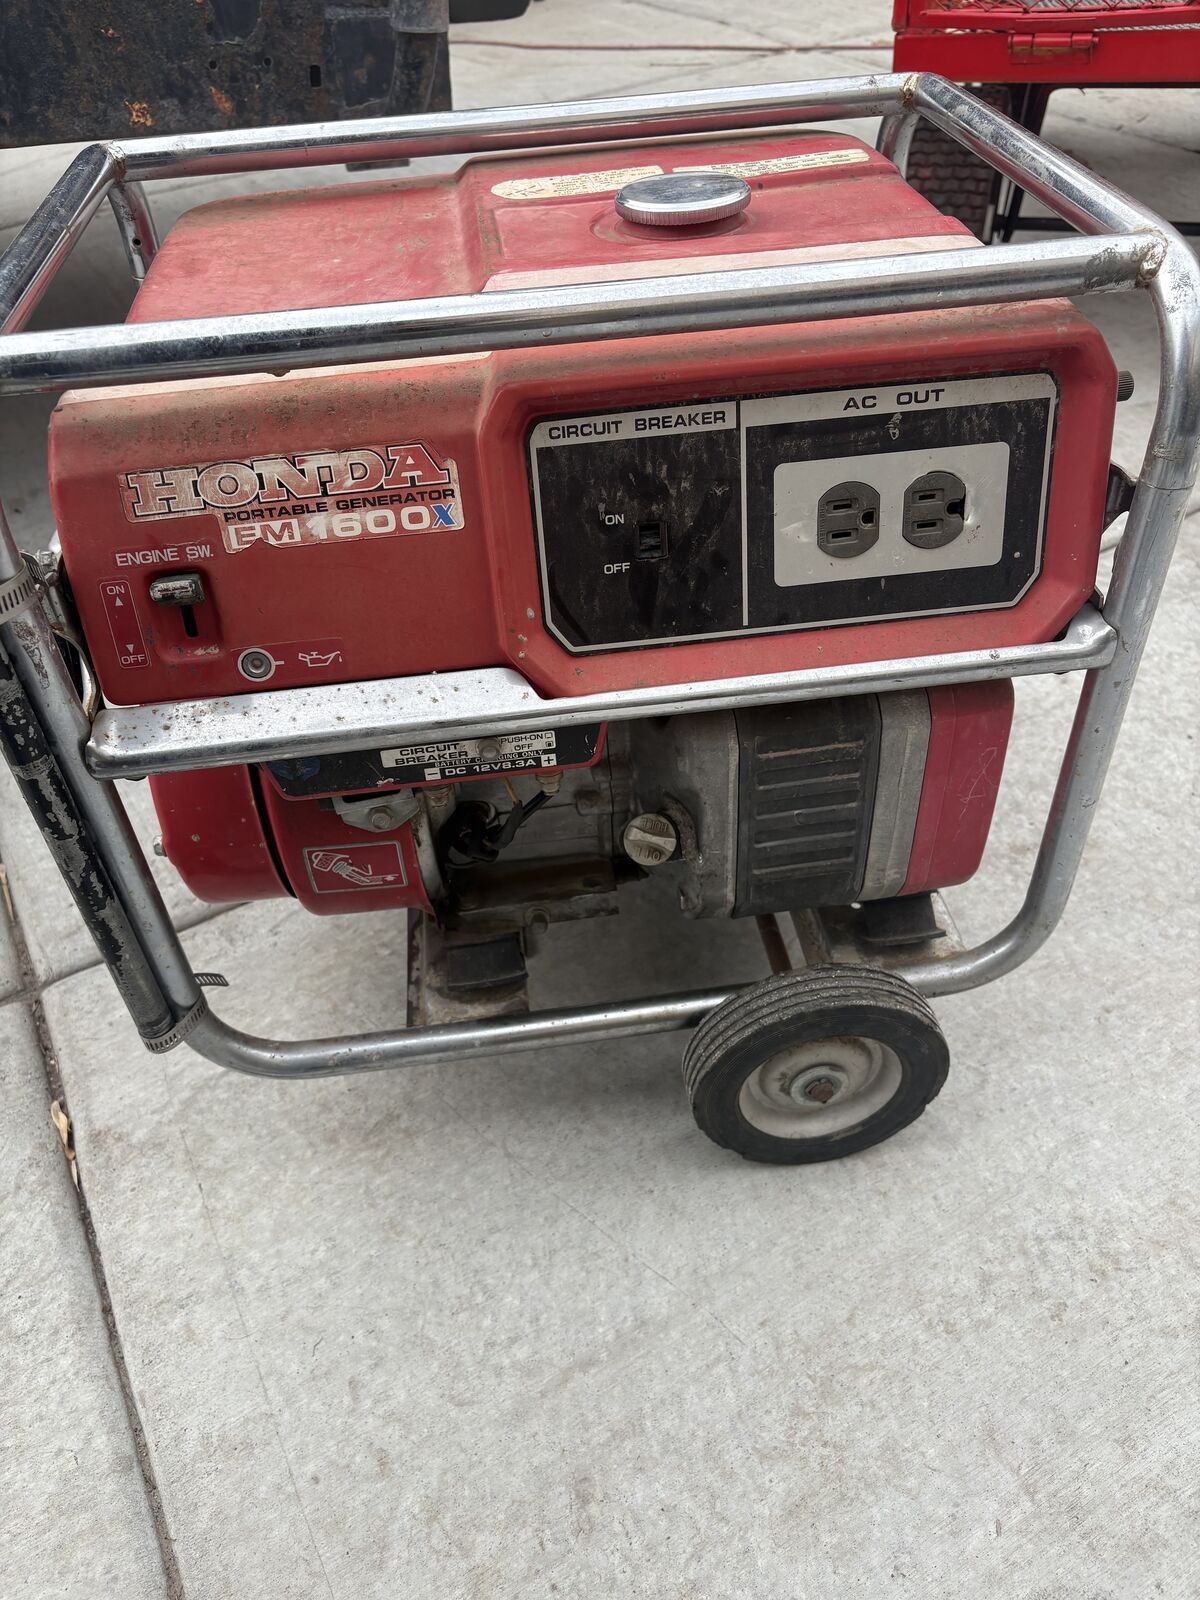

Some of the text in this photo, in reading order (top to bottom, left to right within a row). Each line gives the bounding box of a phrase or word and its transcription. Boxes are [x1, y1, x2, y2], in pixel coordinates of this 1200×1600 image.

[842, 388, 946, 411] AC OUT
[548, 410, 727, 440] CIRCUIT BREAKER
[125, 443, 452, 517] HONDA
[223, 488, 456, 522] PORTABLE GENERATOR
[230, 503, 457, 548] EM 1600X
[605, 513, 625, 525] ON
[115, 544, 214, 567] ENGINE SW.
[603, 562, 631, 575] OFF
[106, 585, 126, 595] ON
[121, 654, 146, 665] OFF
[500, 733, 544, 745] PUSH-ON
[513, 742, 534, 751] OFF
[399, 742, 460, 757] CIRCUIT
[394, 750, 469, 766] BREAKER
[434, 757, 472, 768] BATTERY
[445, 758, 537, 777] DC 12V8.3A
